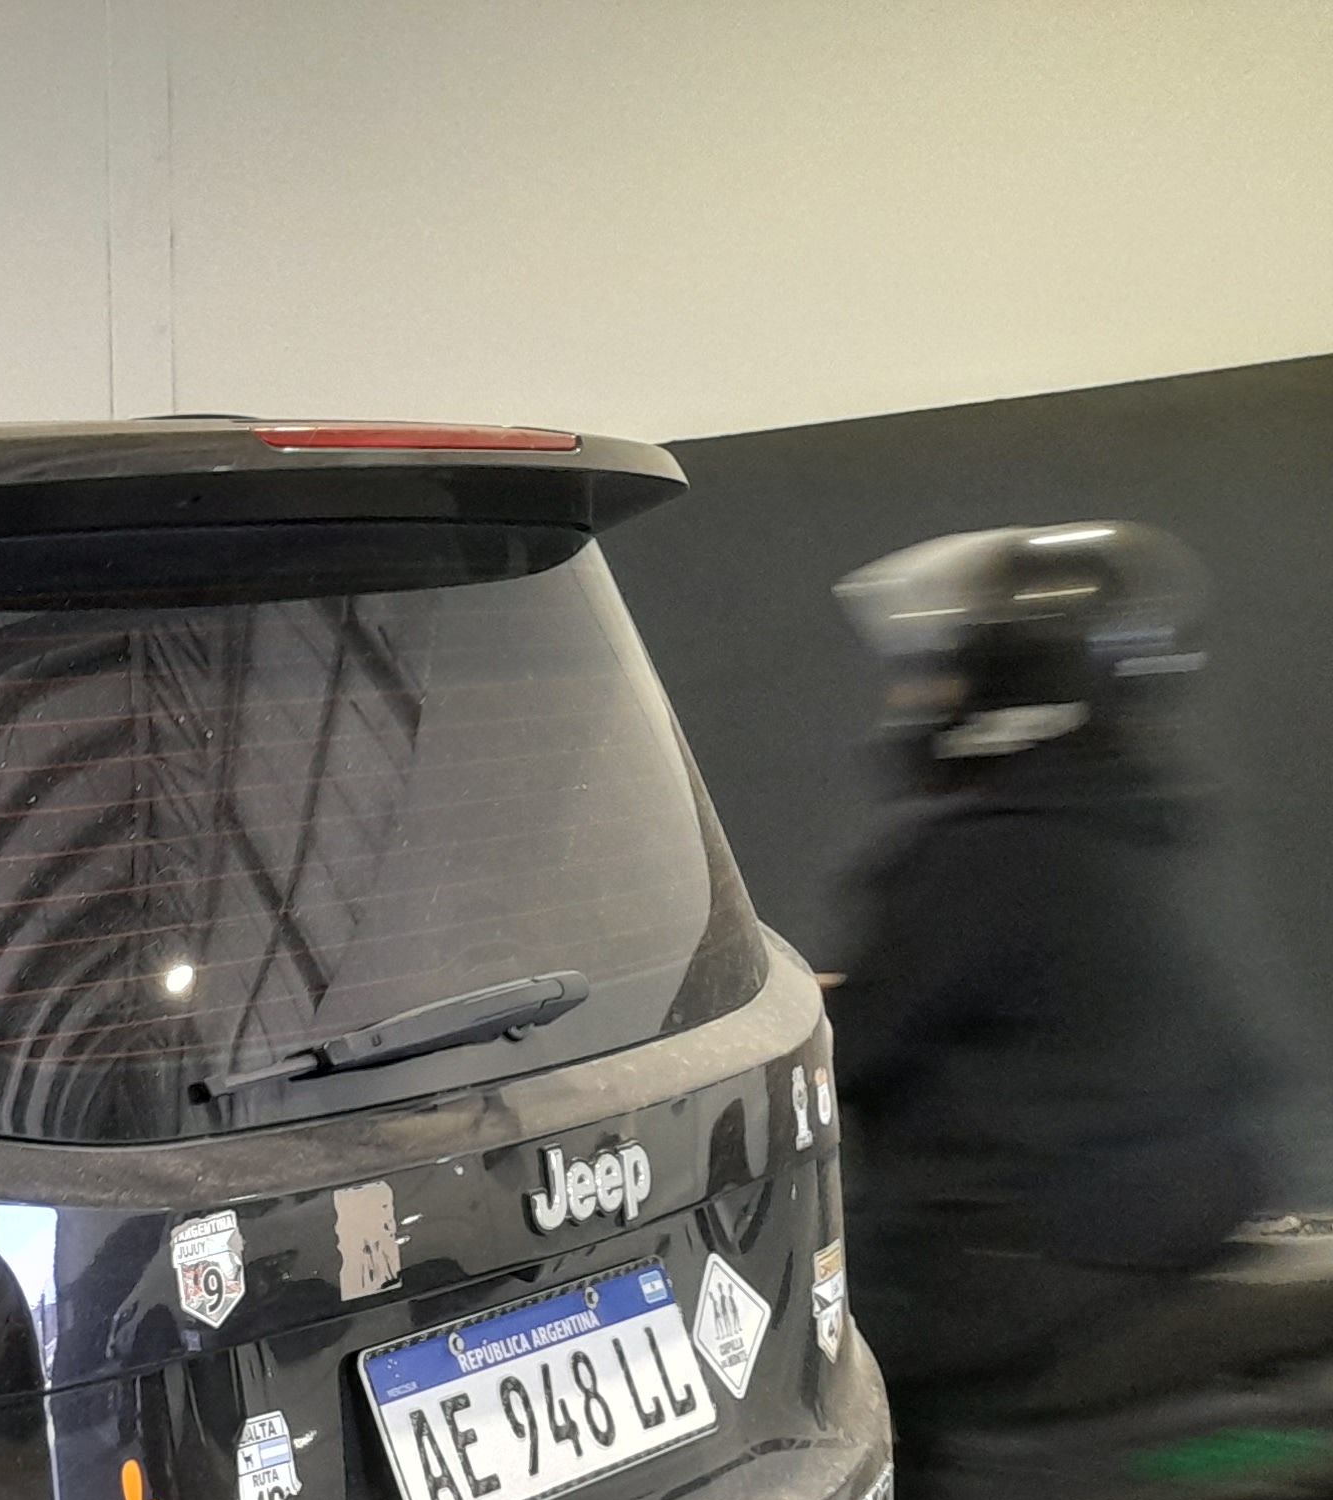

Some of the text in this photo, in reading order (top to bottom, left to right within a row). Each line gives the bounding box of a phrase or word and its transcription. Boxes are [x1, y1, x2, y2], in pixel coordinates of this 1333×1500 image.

[531, 1141, 651, 1231] Jeep
[202, 1267, 224, 1313] 9
[457, 1310, 601, 1373] REPÚBLICA ARGENTINA
[499, 1350, 616, 1477] 948
[612, 1326, 697, 1430] LL
[239, 1420, 277, 1445] ALTA
[252, 1468, 280, 1488] RUTA
